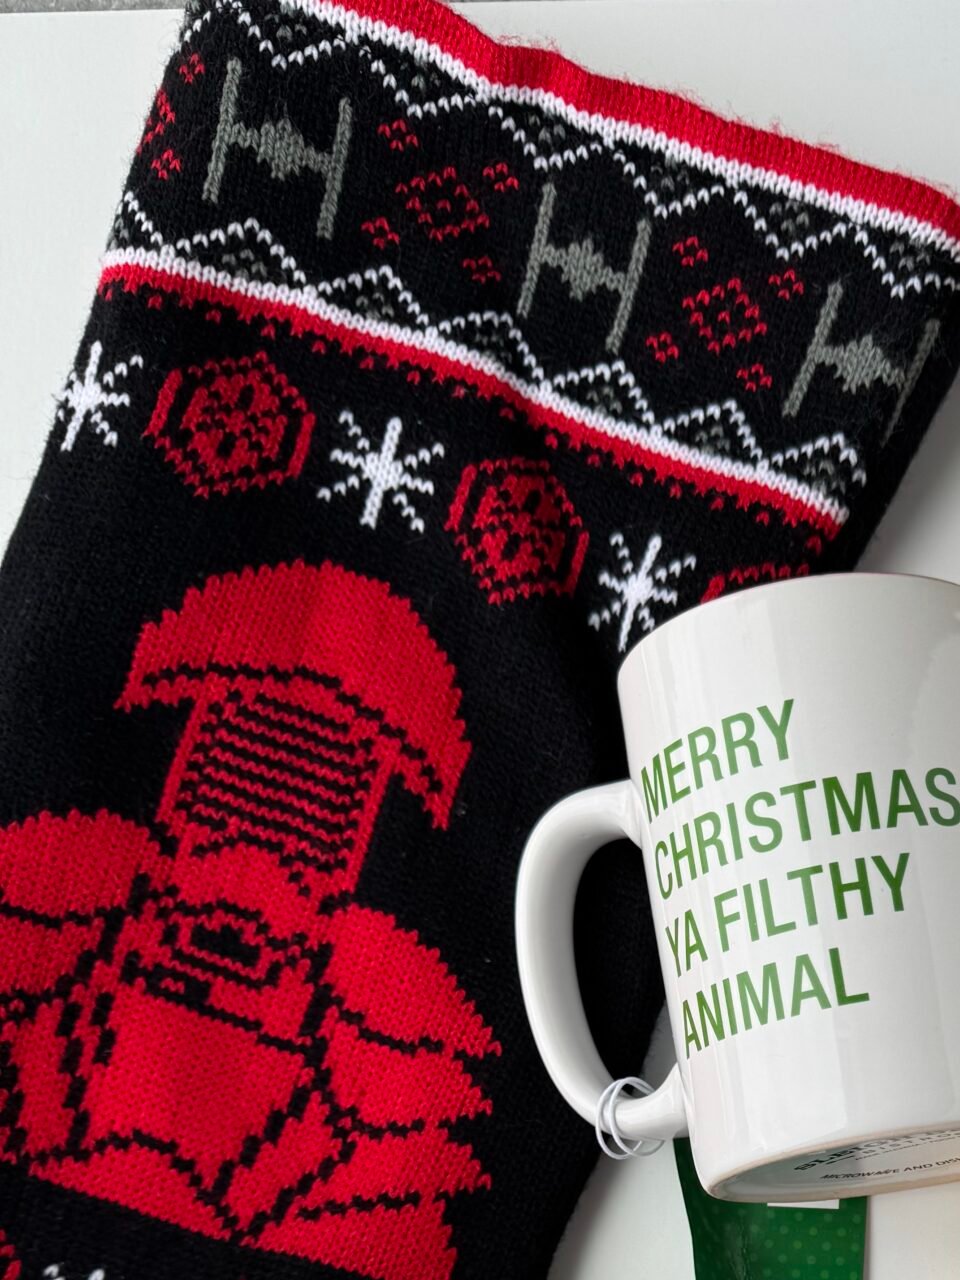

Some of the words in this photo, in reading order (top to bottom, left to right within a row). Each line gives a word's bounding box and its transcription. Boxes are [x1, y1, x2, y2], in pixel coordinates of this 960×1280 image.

[641, 699, 795, 824] MERRY
[665, 909, 709, 978] YA
[714, 852, 910, 952] FILTHY
[682, 947, 871, 1059] ANIMAL
[820, 1167, 900, 1179] MICROWAVE
[904, 1163, 933, 1173] AND
